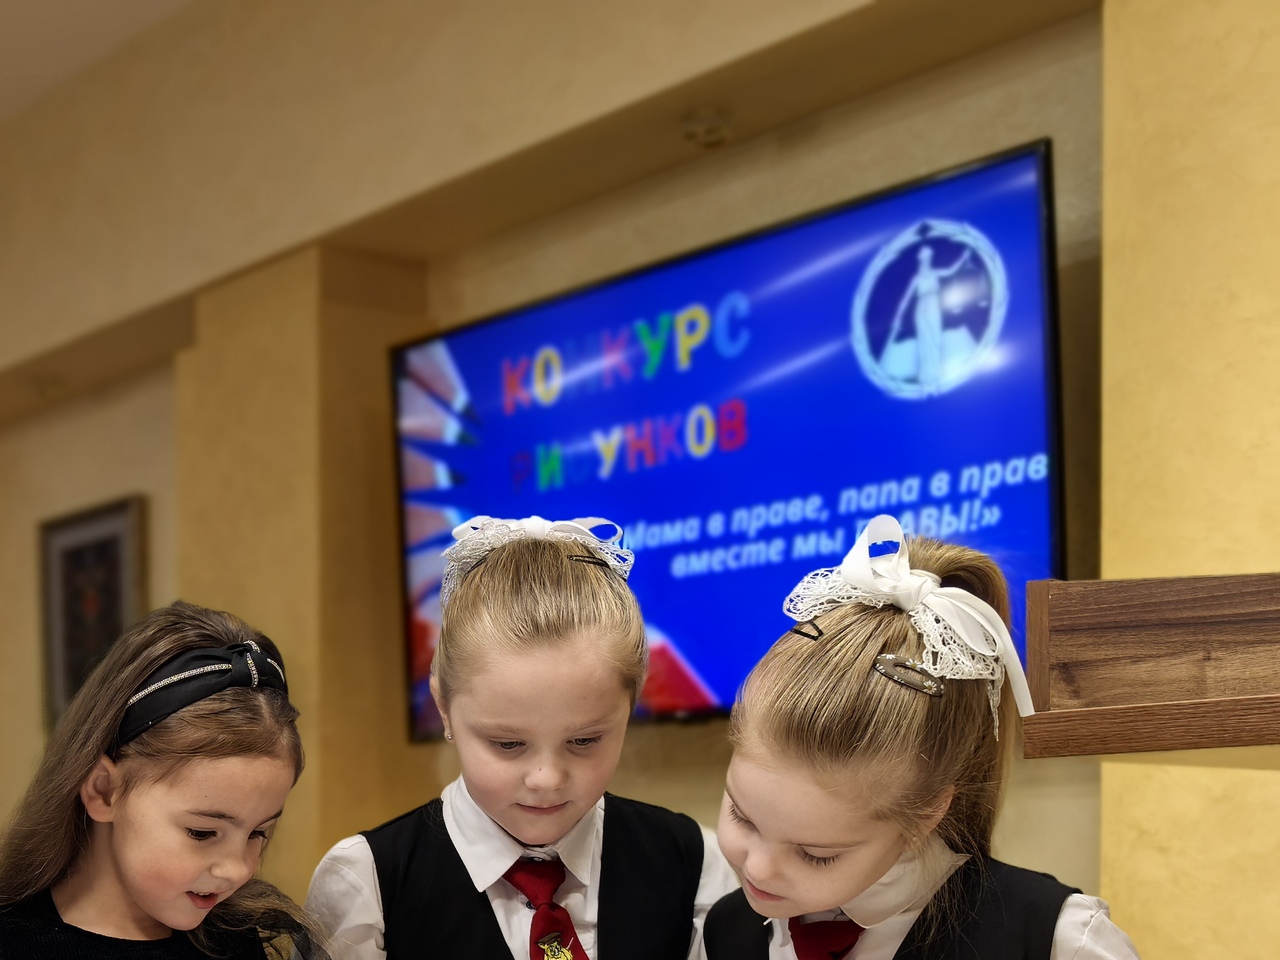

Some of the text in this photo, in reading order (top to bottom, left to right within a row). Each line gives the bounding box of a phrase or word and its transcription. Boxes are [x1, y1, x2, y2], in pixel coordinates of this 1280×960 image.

[510, 399, 747, 494] РИУНКОВ
[612, 519, 700, 551] Мама
[706, 511, 725, 538] в
[730, 493, 828, 536] праве,
[838, 475, 921, 515] папа
[929, 470, 950, 498] в
[671, 499, 1002, 579] вместе мы АВЫ!»
